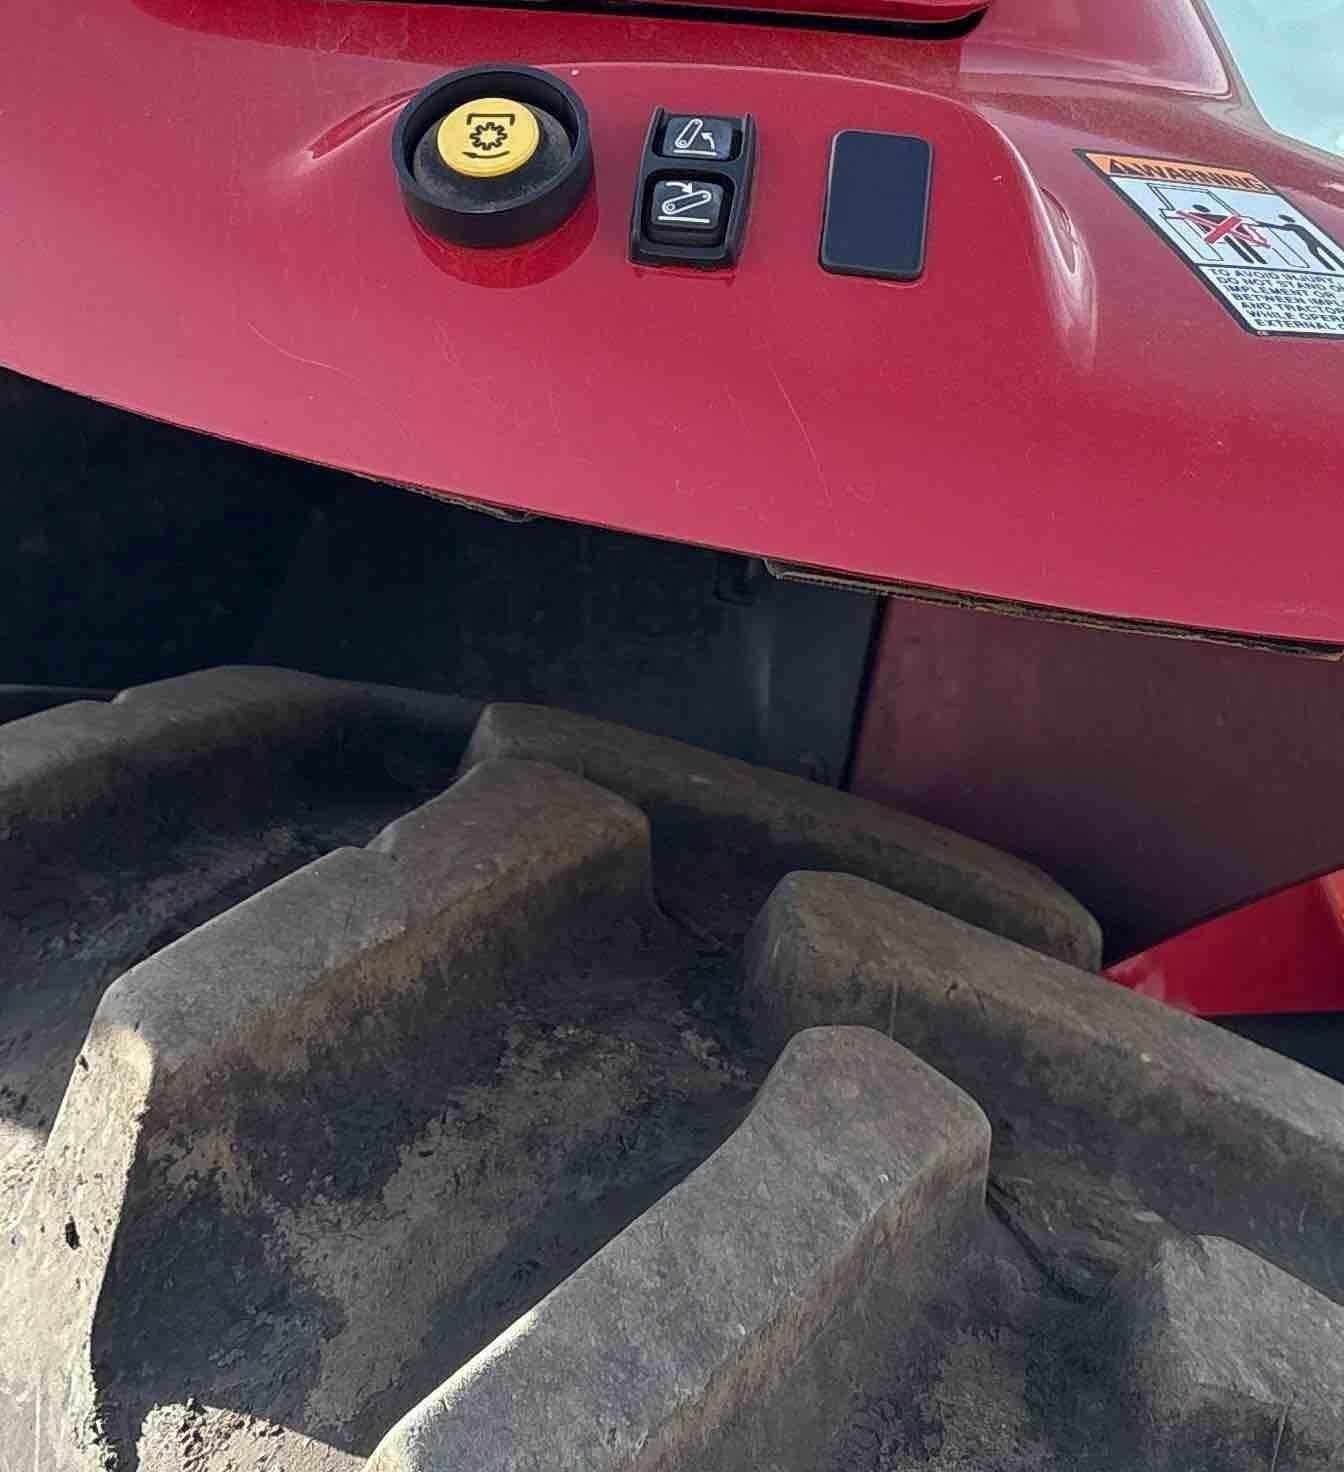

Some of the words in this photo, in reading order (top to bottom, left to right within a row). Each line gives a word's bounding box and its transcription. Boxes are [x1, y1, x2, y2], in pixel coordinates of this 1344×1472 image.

[1133, 162, 1270, 192] WARNING
[1210, 268, 1230, 277] TO
[1235, 270, 1281, 280] AVOID
[1282, 273, 1335, 284] INJURY
[1215, 276, 1241, 285] DO
[1242, 278, 1273, 287] NOT
[1276, 280, 1328, 290] STAND
[1225, 285, 1309, 297] IMPLEMENT
[1312, 290, 1337, 299] OR
[1232, 293, 1306, 304] BETWEEN
[1241, 302, 1273, 311] AND
[1246, 309, 1296, 320] WHILE
[1255, 318, 1333, 330] EXTERNAL
